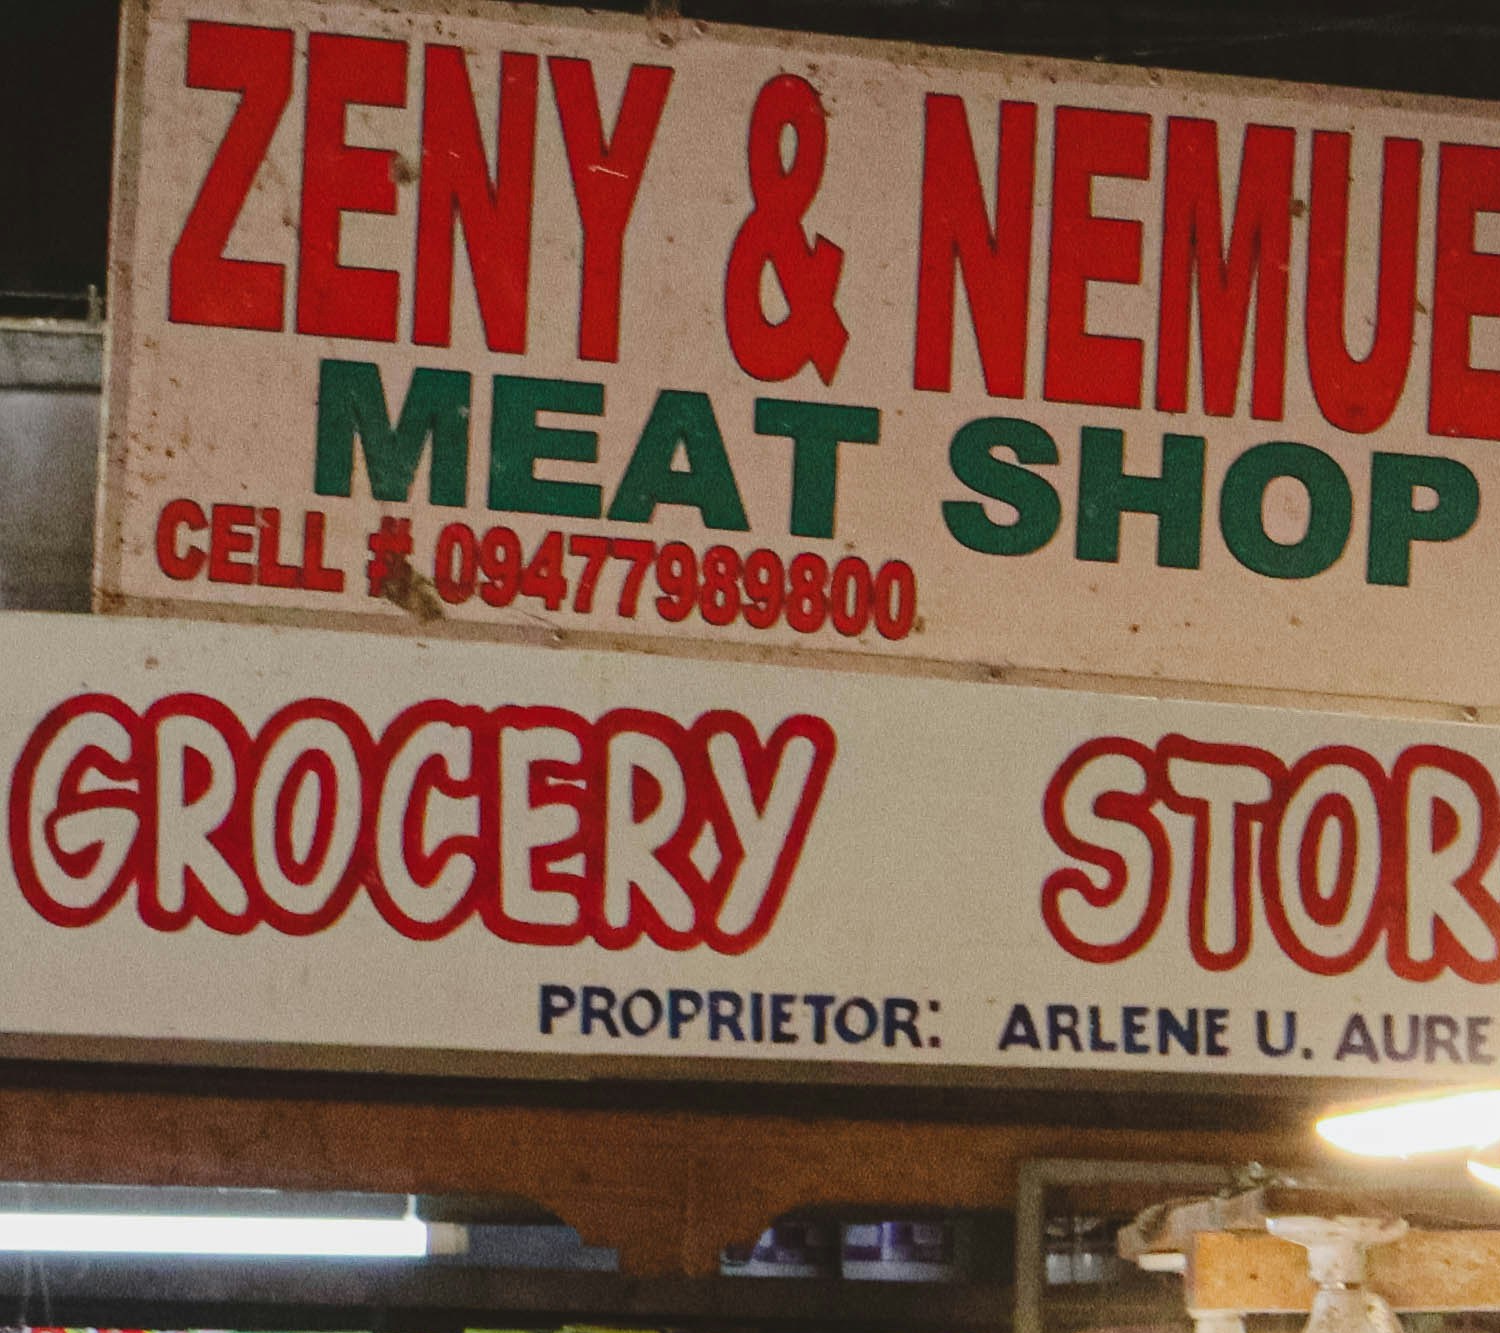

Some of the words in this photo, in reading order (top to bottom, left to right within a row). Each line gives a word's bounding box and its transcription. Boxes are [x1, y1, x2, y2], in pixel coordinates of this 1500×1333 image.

[168, 21, 674, 363] ZENY
[723, 74, 850, 385] &
[155, 498, 344, 595] CELL
[434, 523, 916, 641] 09477989800
[313, 359, 881, 539] MEAT
[941, 417, 1479, 588] SHOP
[10, 692, 837, 955] GROCERY
[539, 984, 943, 1049] PROPRIETOR:
[1000, 1003, 1229, 1057] ARLENE
[1257, 1009, 1313, 1061] U.
[1336, 1013, 1497, 1064] AURE
